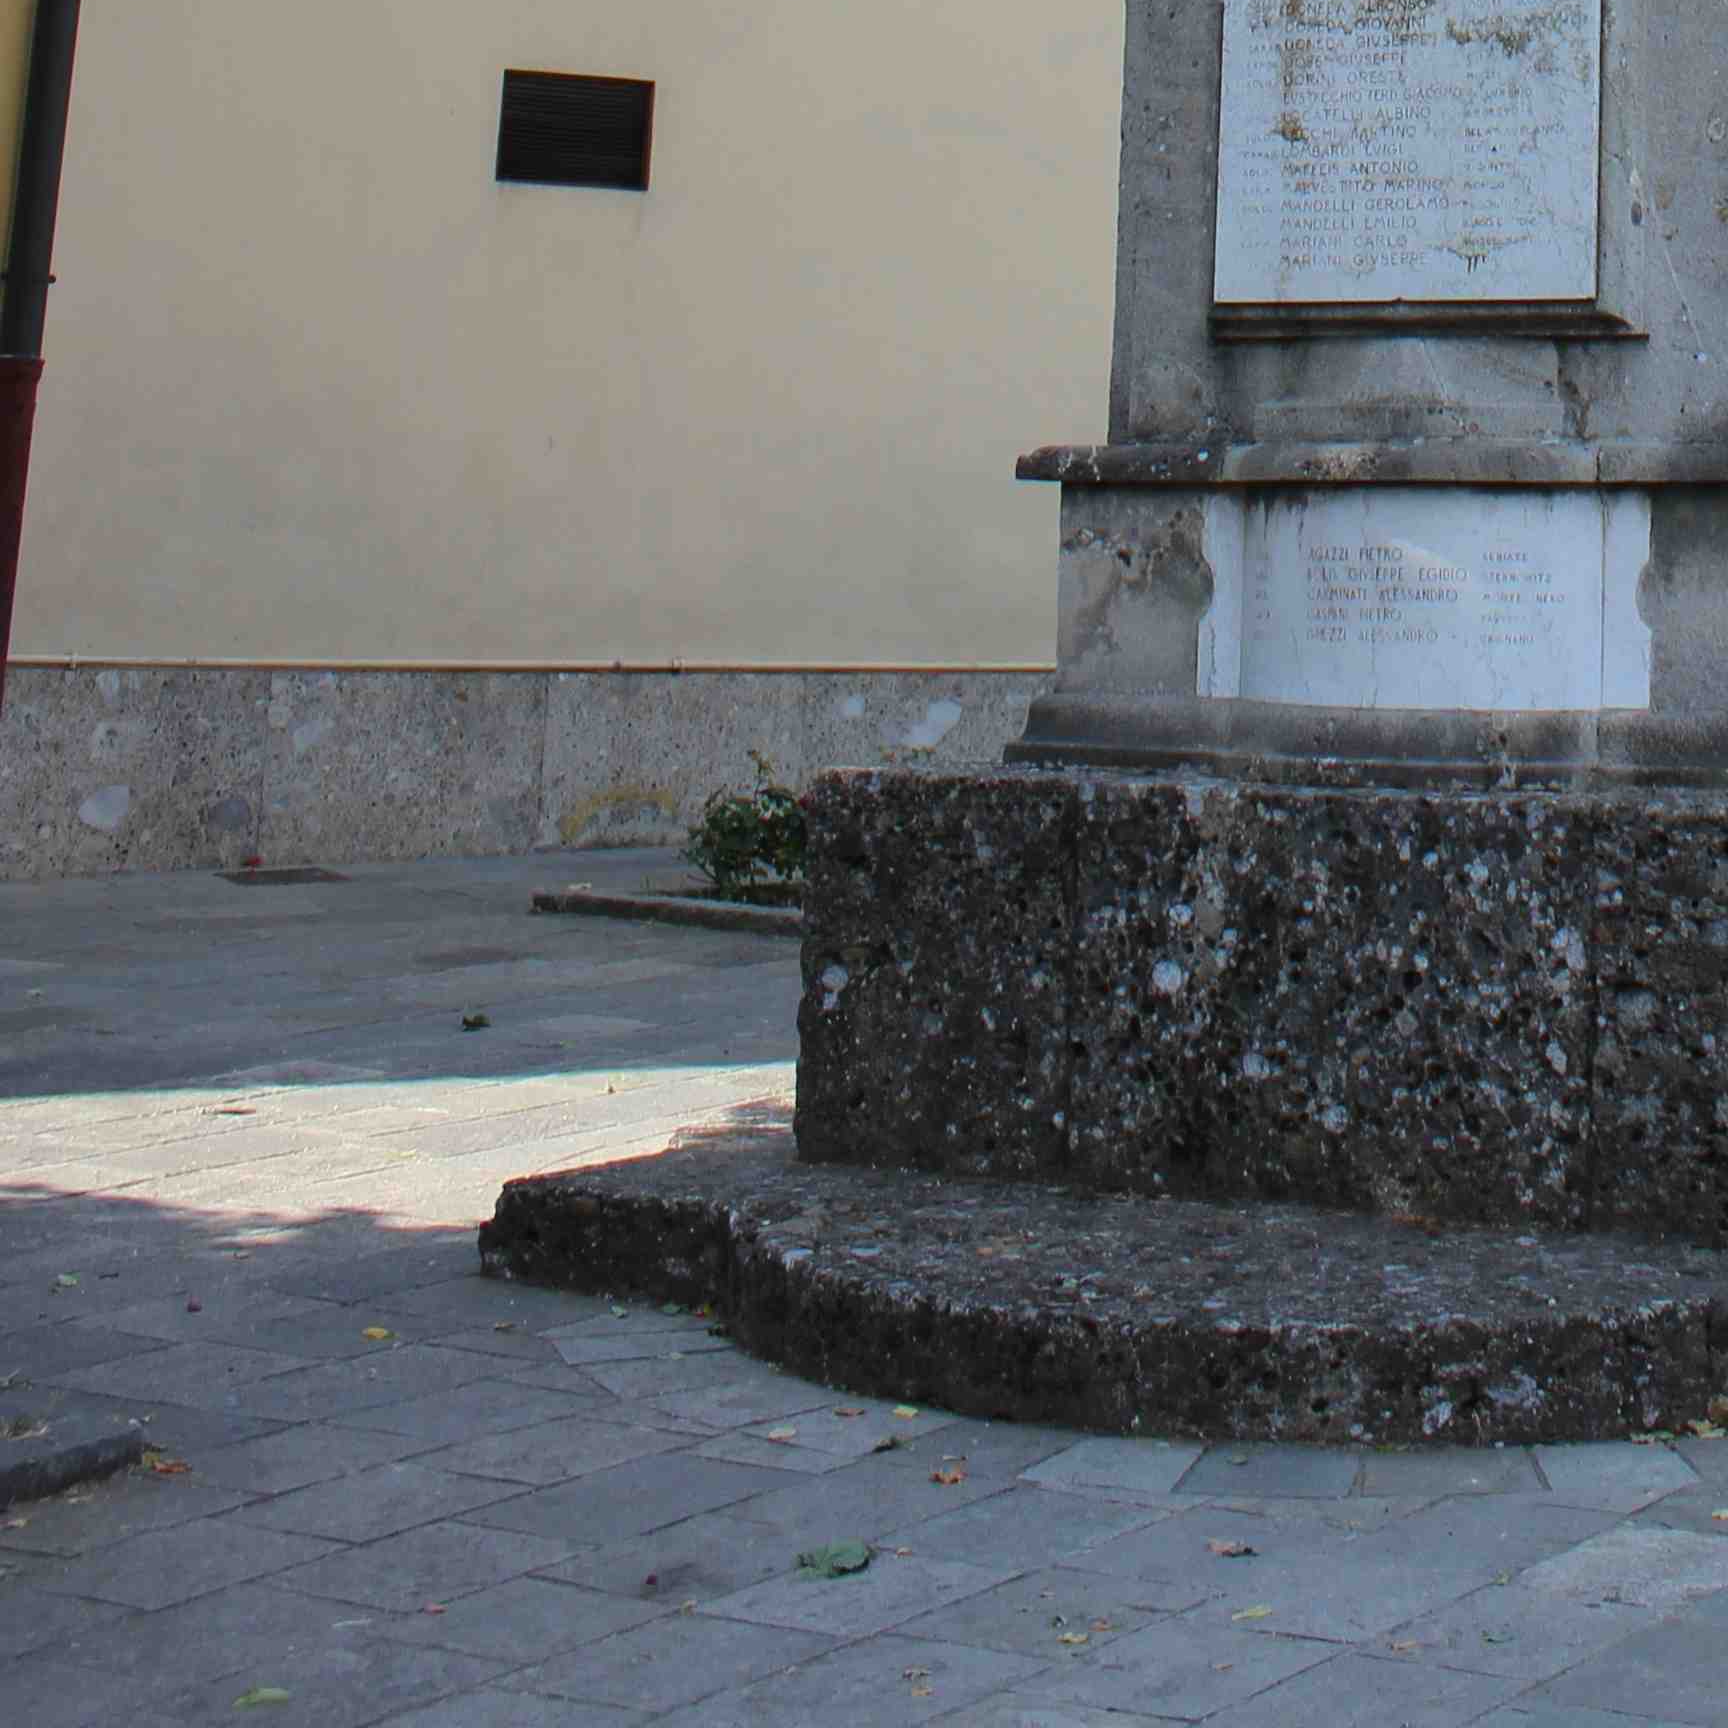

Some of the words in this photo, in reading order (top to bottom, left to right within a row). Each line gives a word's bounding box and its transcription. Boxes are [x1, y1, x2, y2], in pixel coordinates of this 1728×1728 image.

[1355, 15, 1428, 31] GIOVANNI
[1375, 105, 1432, 121] ALBINO
[1350, 160, 1419, 175] ANTONIO
[1280, 199, 1355, 213] MANDELLI
[1364, 196, 1449, 211] GEROLAMO
[1280, 217, 1355, 232] MANDELLI
[1364, 215, 1418, 230] EMILIO
[1353, 234, 1408, 249] CARLO
[1360, 546, 1404, 561] PIETRO
[1418, 566, 1469, 582] EGIDIO
